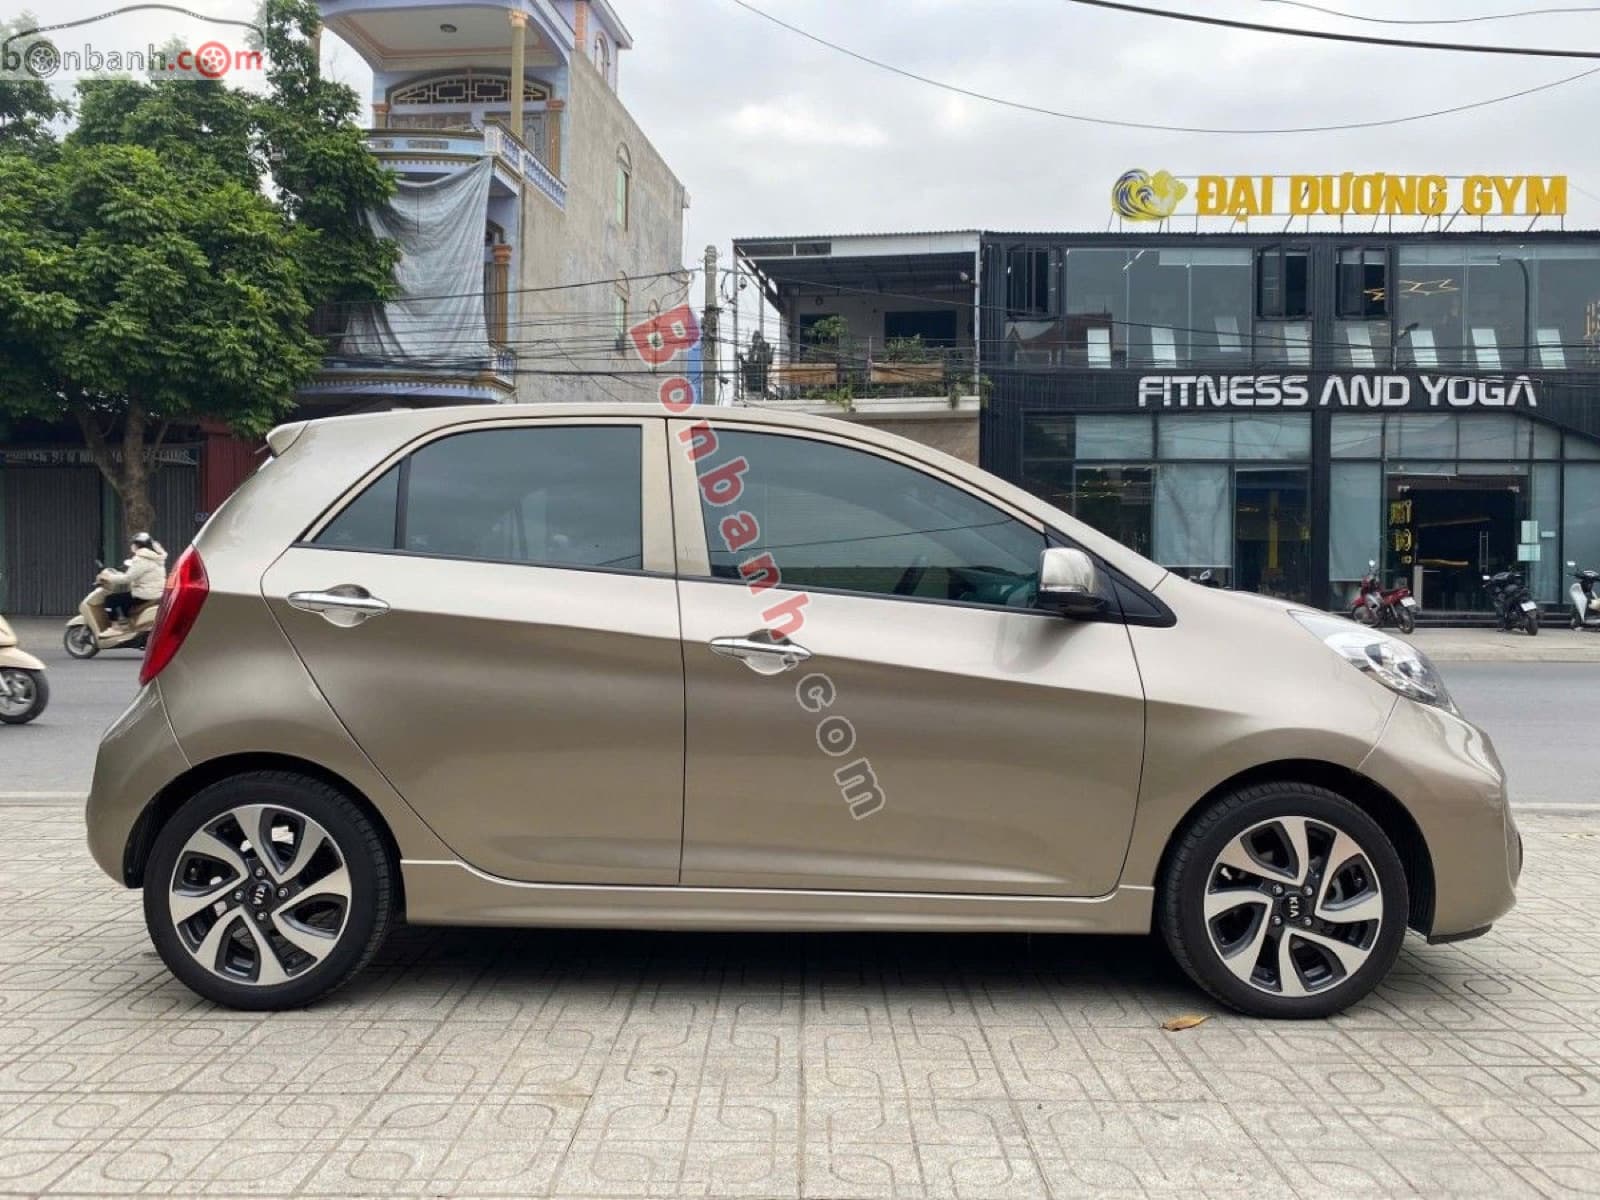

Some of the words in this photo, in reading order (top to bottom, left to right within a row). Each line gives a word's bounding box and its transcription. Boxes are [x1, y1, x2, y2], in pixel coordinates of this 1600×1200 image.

[1195, 175, 1273, 222] ĐẠI
[1290, 171, 1448, 216] DƯƠNG
[1462, 175, 1568, 216] GYM
[1138, 375, 1309, 407] FITNESS
[1319, 375, 1410, 407] AND
[1419, 375, 1537, 407] YOGA
[1288, 896, 1301, 918] KIA
